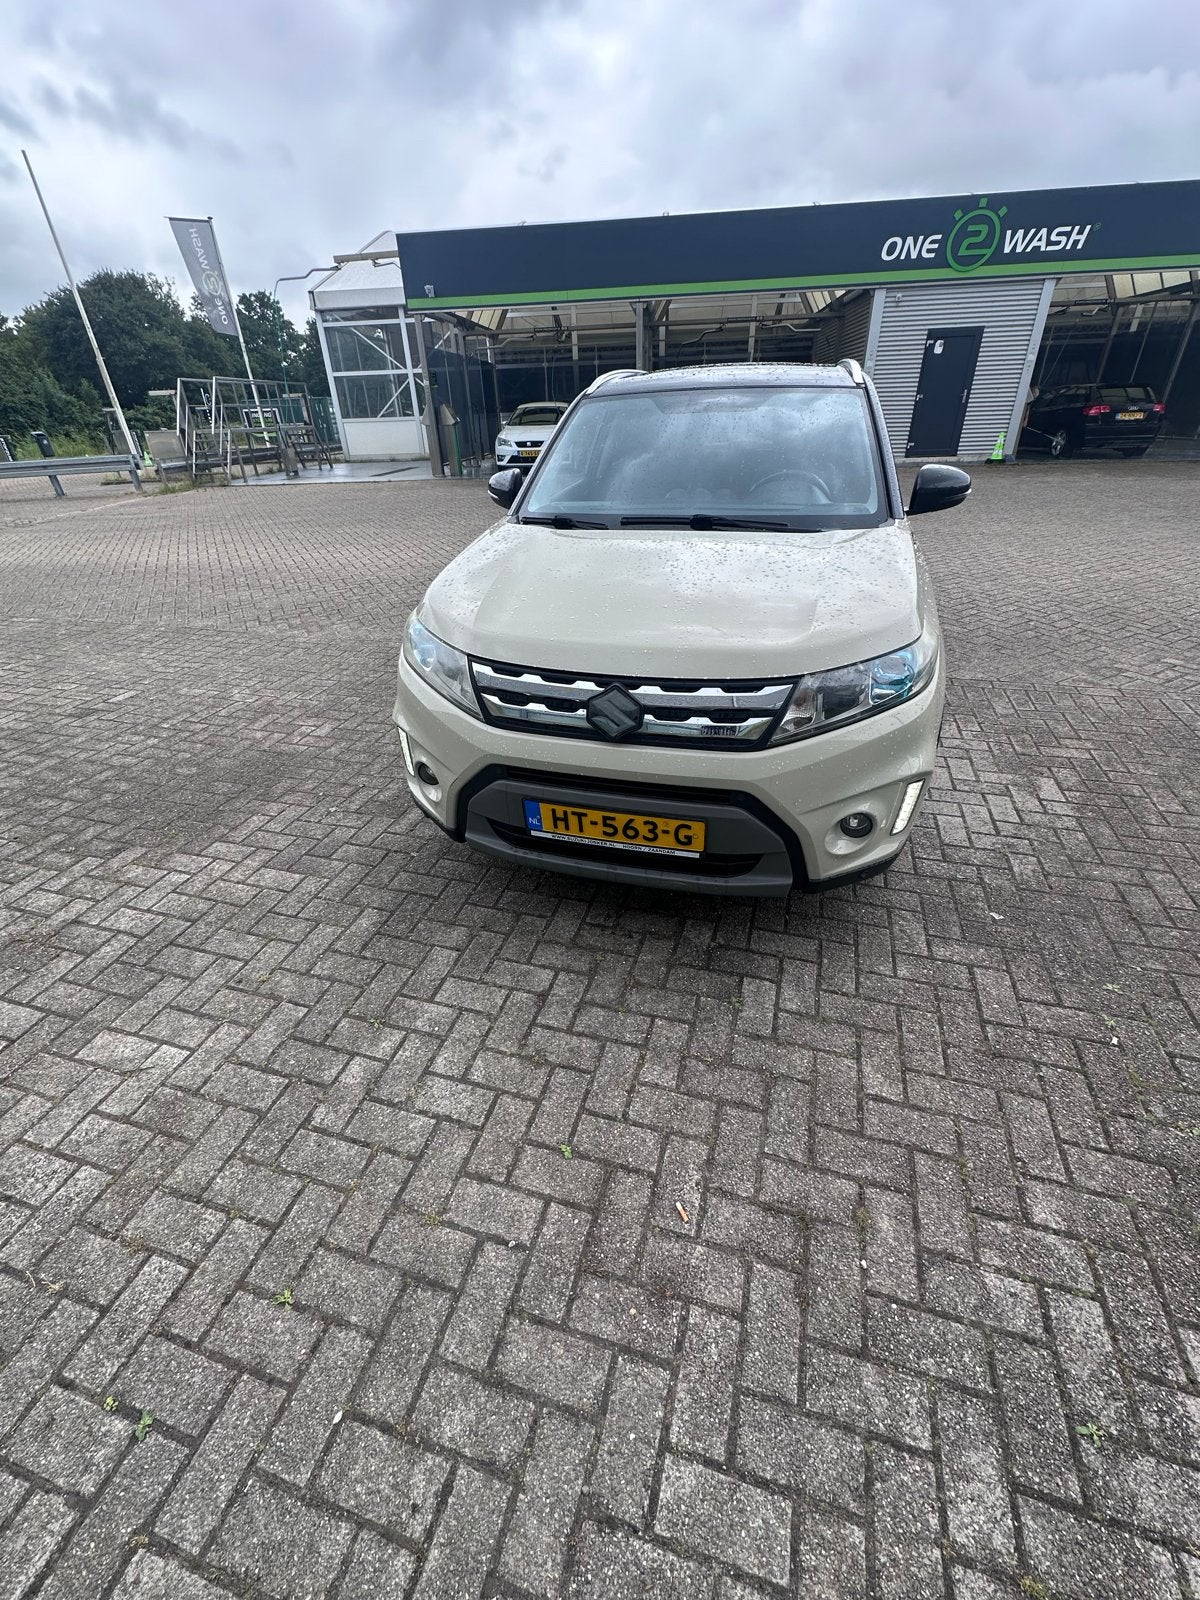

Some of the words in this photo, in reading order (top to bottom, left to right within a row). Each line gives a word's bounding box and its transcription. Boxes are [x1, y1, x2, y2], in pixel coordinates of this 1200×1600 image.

[881, 234, 942, 261] ONE
[958, 223, 991, 256] 2
[1003, 225, 1091, 254] WASH
[529, 817, 541, 826] NL
[551, 808, 693, 846] HT-563-G
